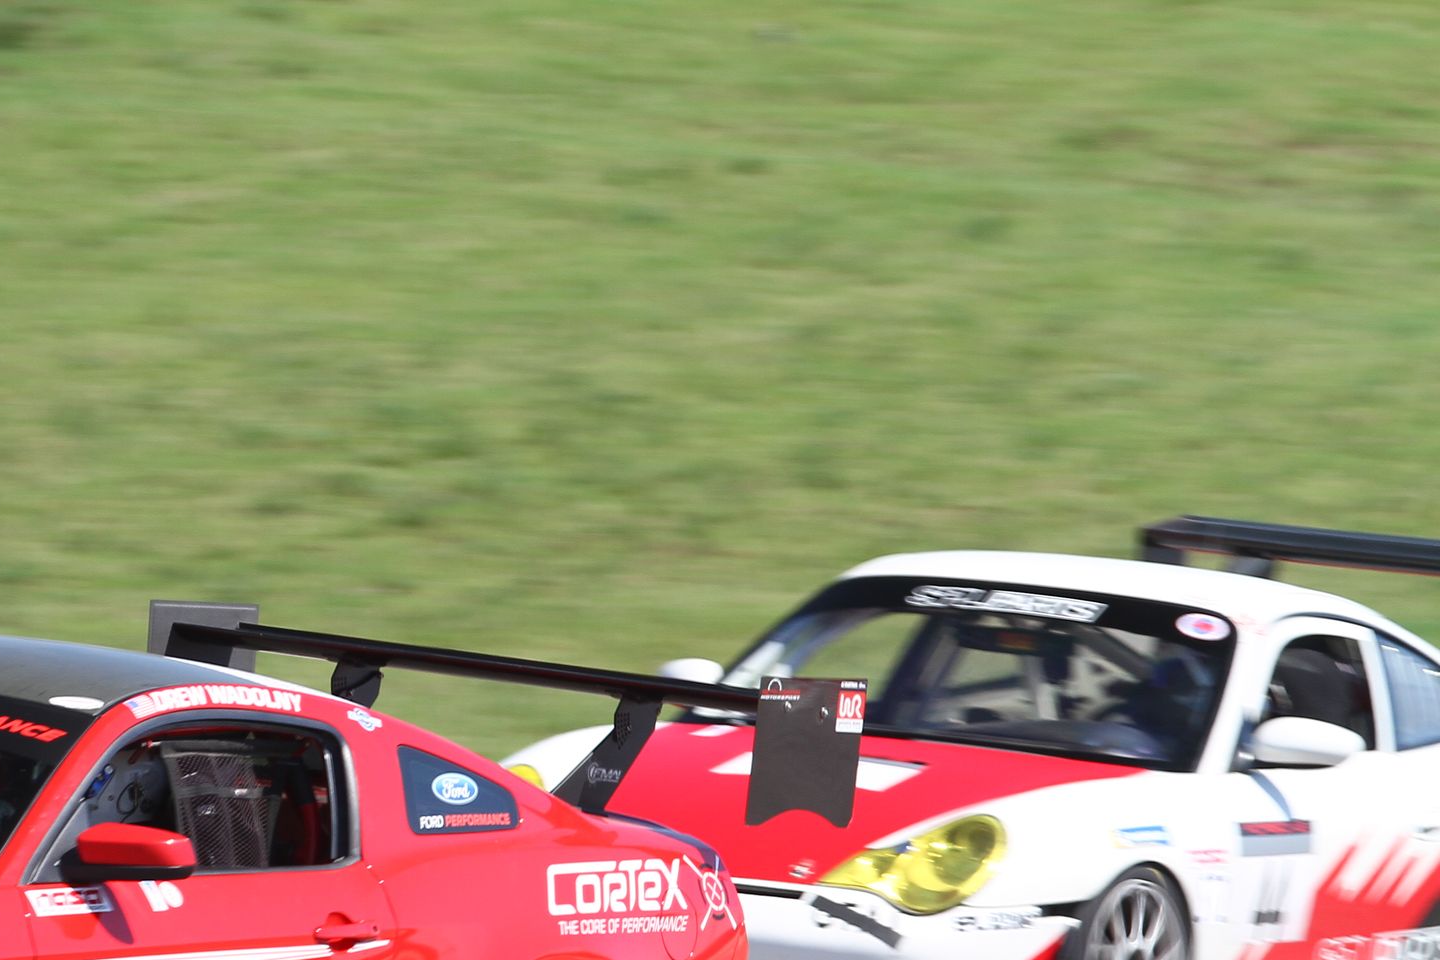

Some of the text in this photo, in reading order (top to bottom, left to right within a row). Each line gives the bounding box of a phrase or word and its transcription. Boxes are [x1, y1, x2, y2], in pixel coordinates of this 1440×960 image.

[442, 778, 472, 799] Ford
[420, 812, 511, 829] FORD PERFORMANCE
[558, 915, 688, 935] THE CORE OF PERFORMANCE
